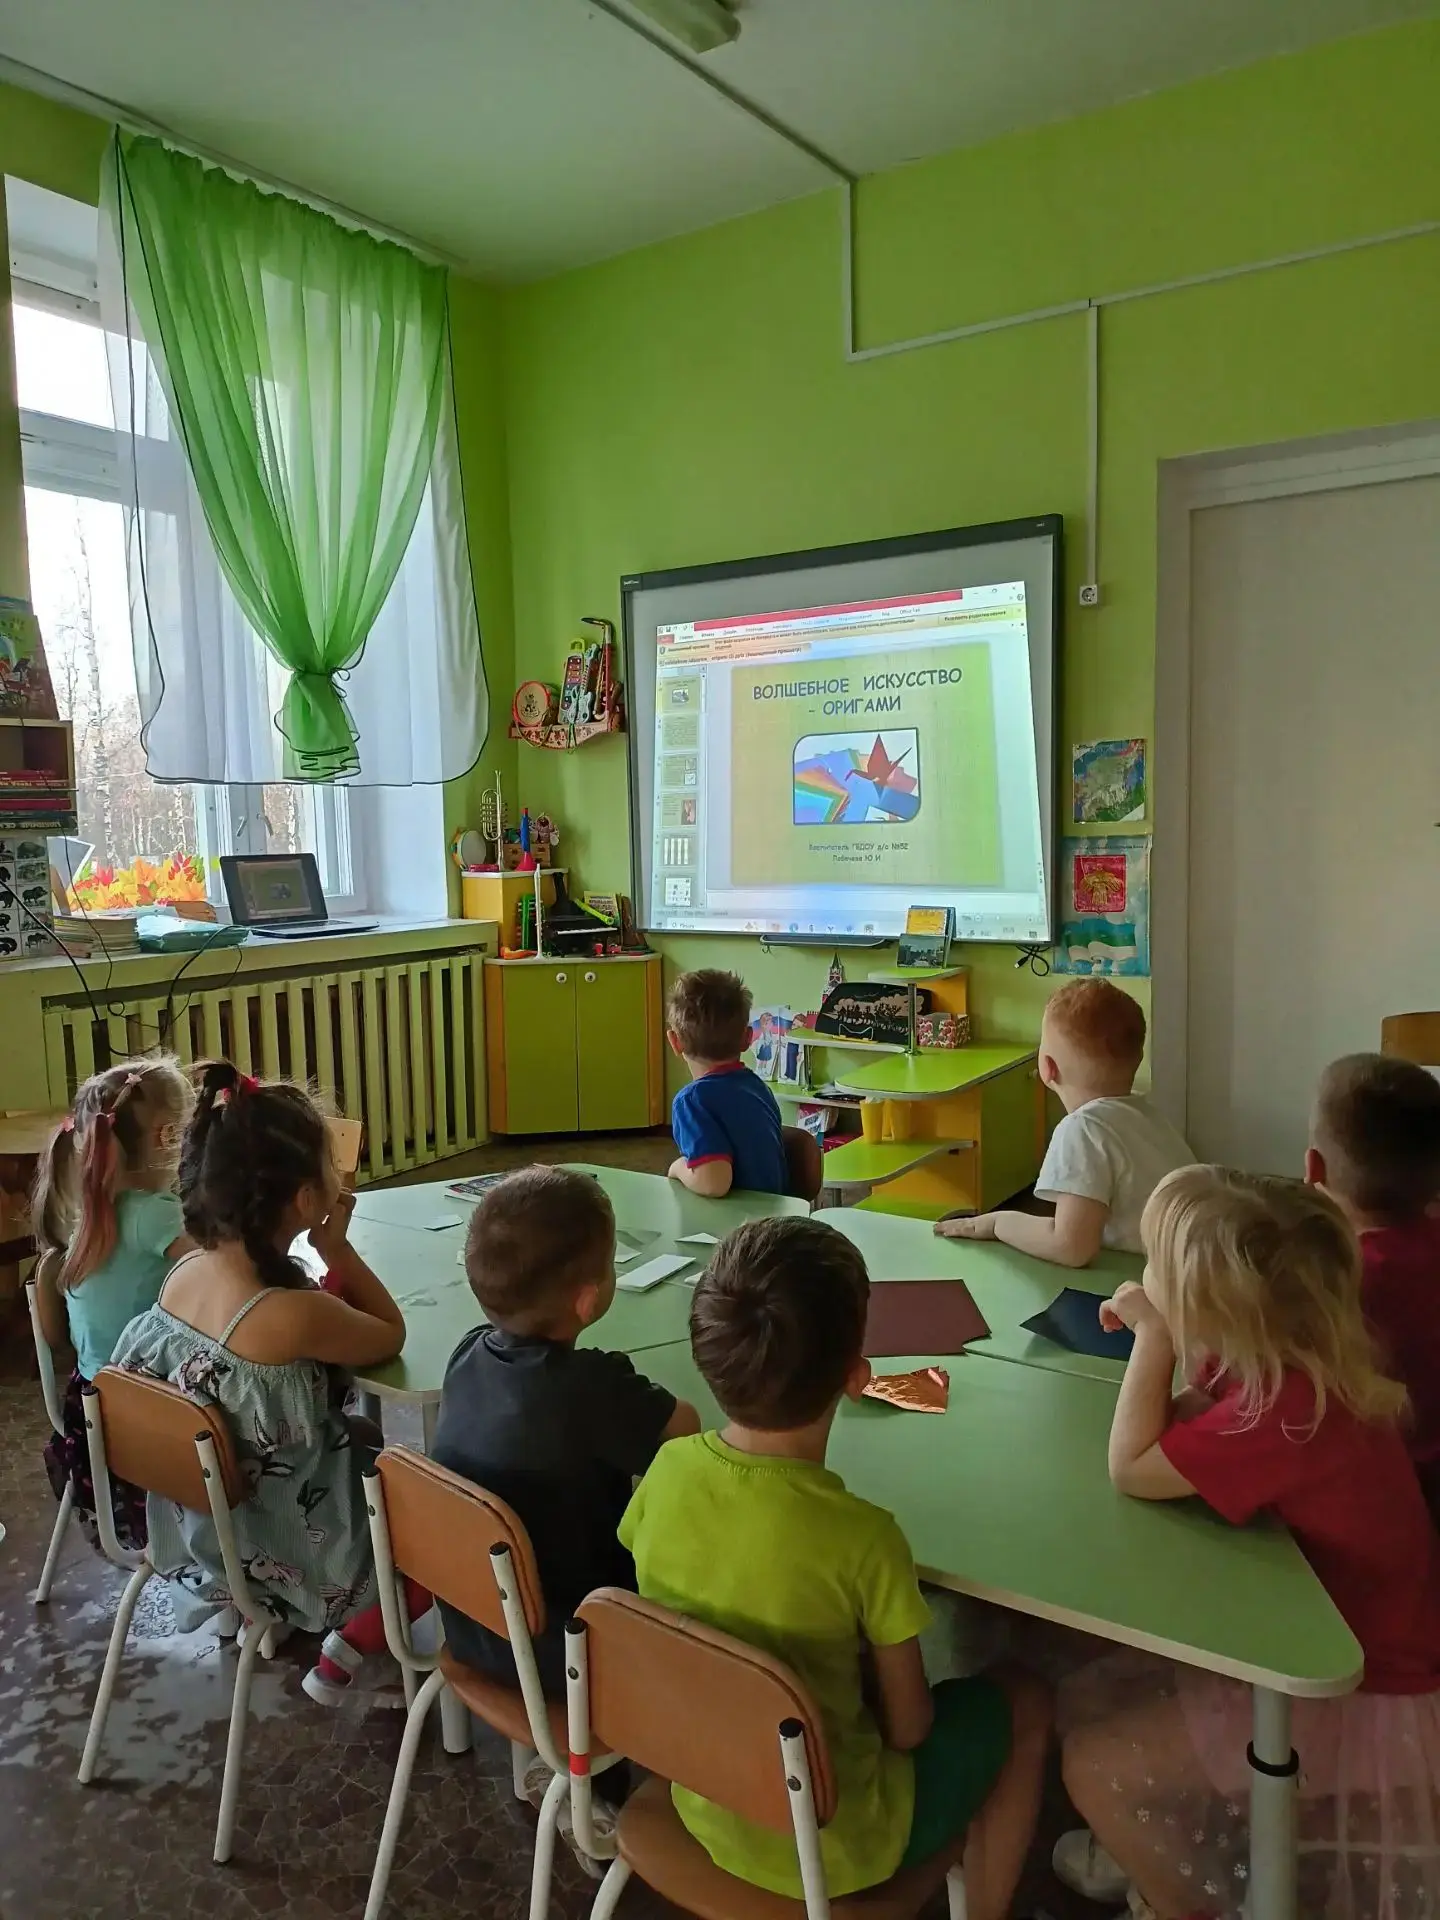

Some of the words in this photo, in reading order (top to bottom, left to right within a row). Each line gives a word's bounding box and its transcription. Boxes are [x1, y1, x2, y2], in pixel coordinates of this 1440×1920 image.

[753, 678, 850, 701] ВОЛШЕБНОЕ
[863, 667, 963, 691] ИСКУССТВО
[822, 695, 902, 716] ОРИГАМИ
